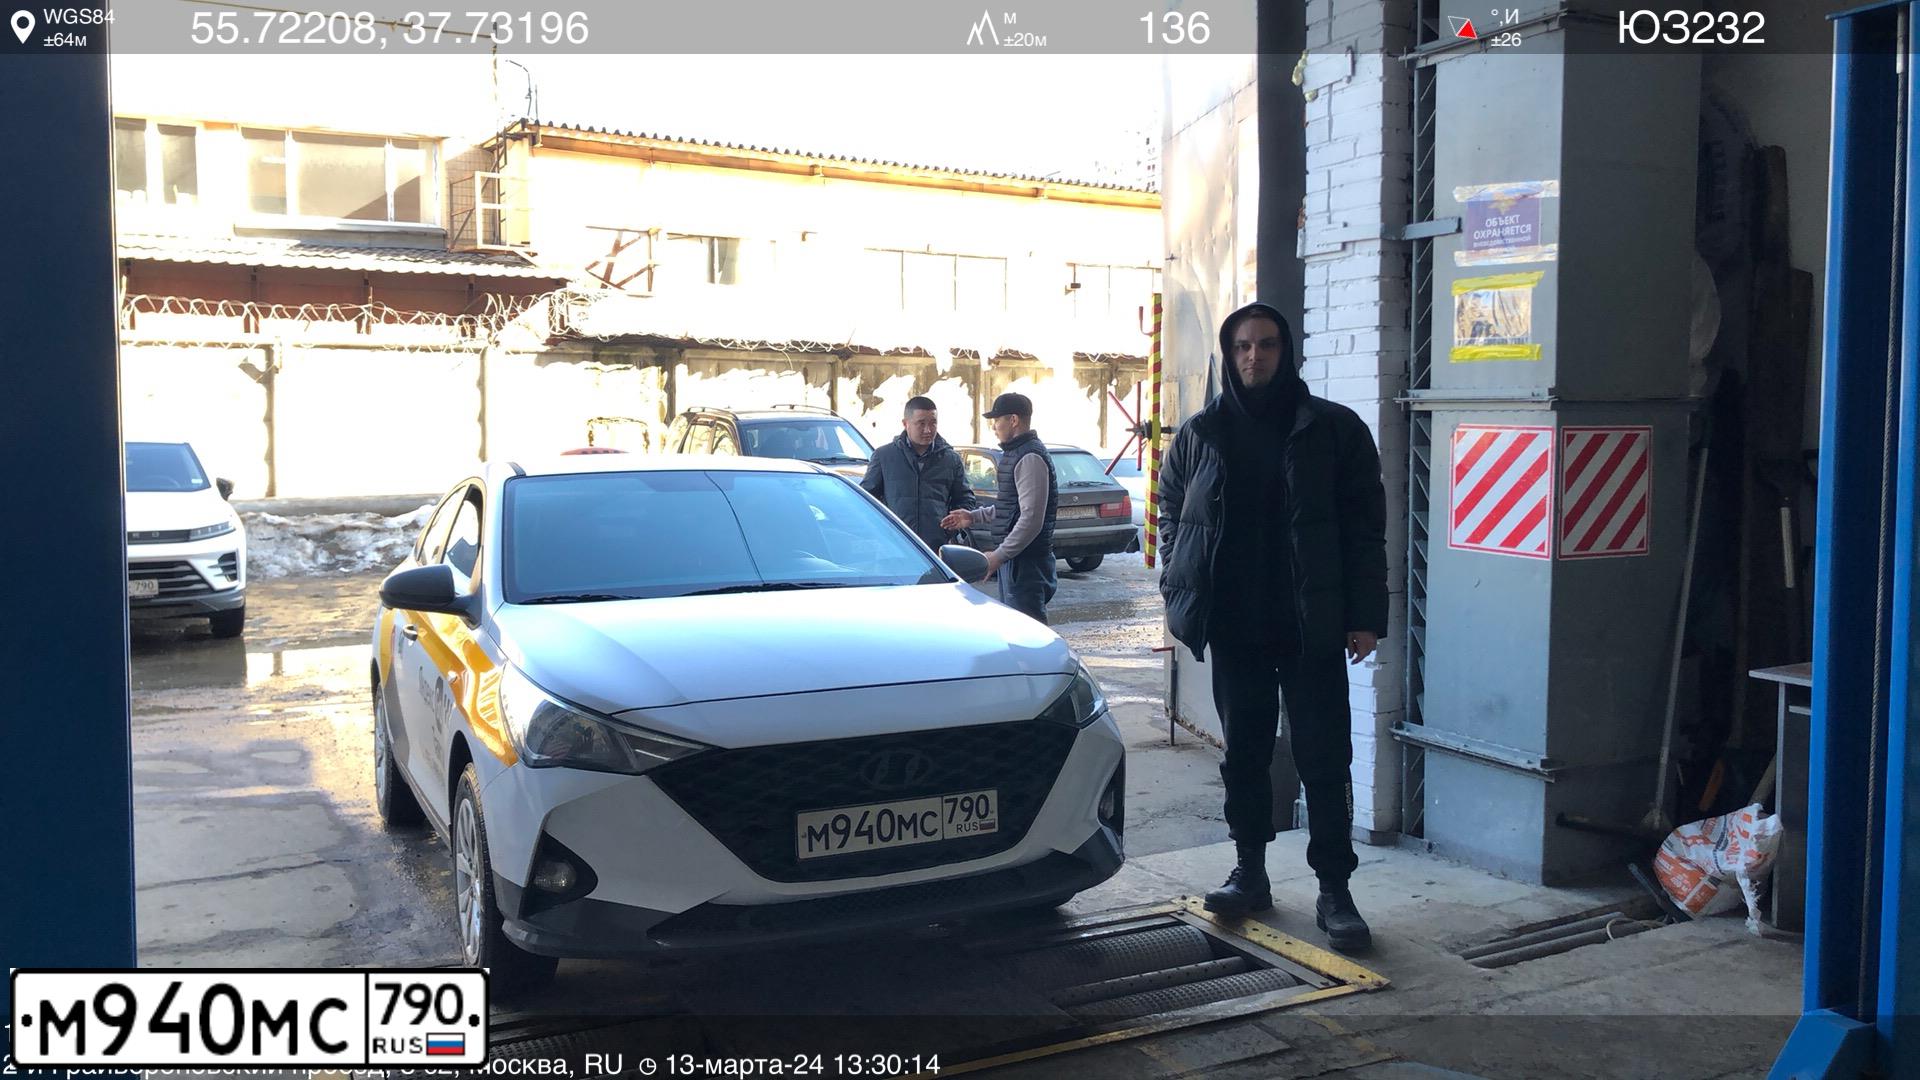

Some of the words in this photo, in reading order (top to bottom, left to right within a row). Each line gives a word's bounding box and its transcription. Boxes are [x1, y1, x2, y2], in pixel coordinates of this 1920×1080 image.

[1485, 214, 1521, 228] ОБЪЕКТ
[1473, 223, 1532, 240] ОХРАНЯЕТСЯ
[944, 794, 990, 825] 790
[956, 820, 980, 833] RUS
